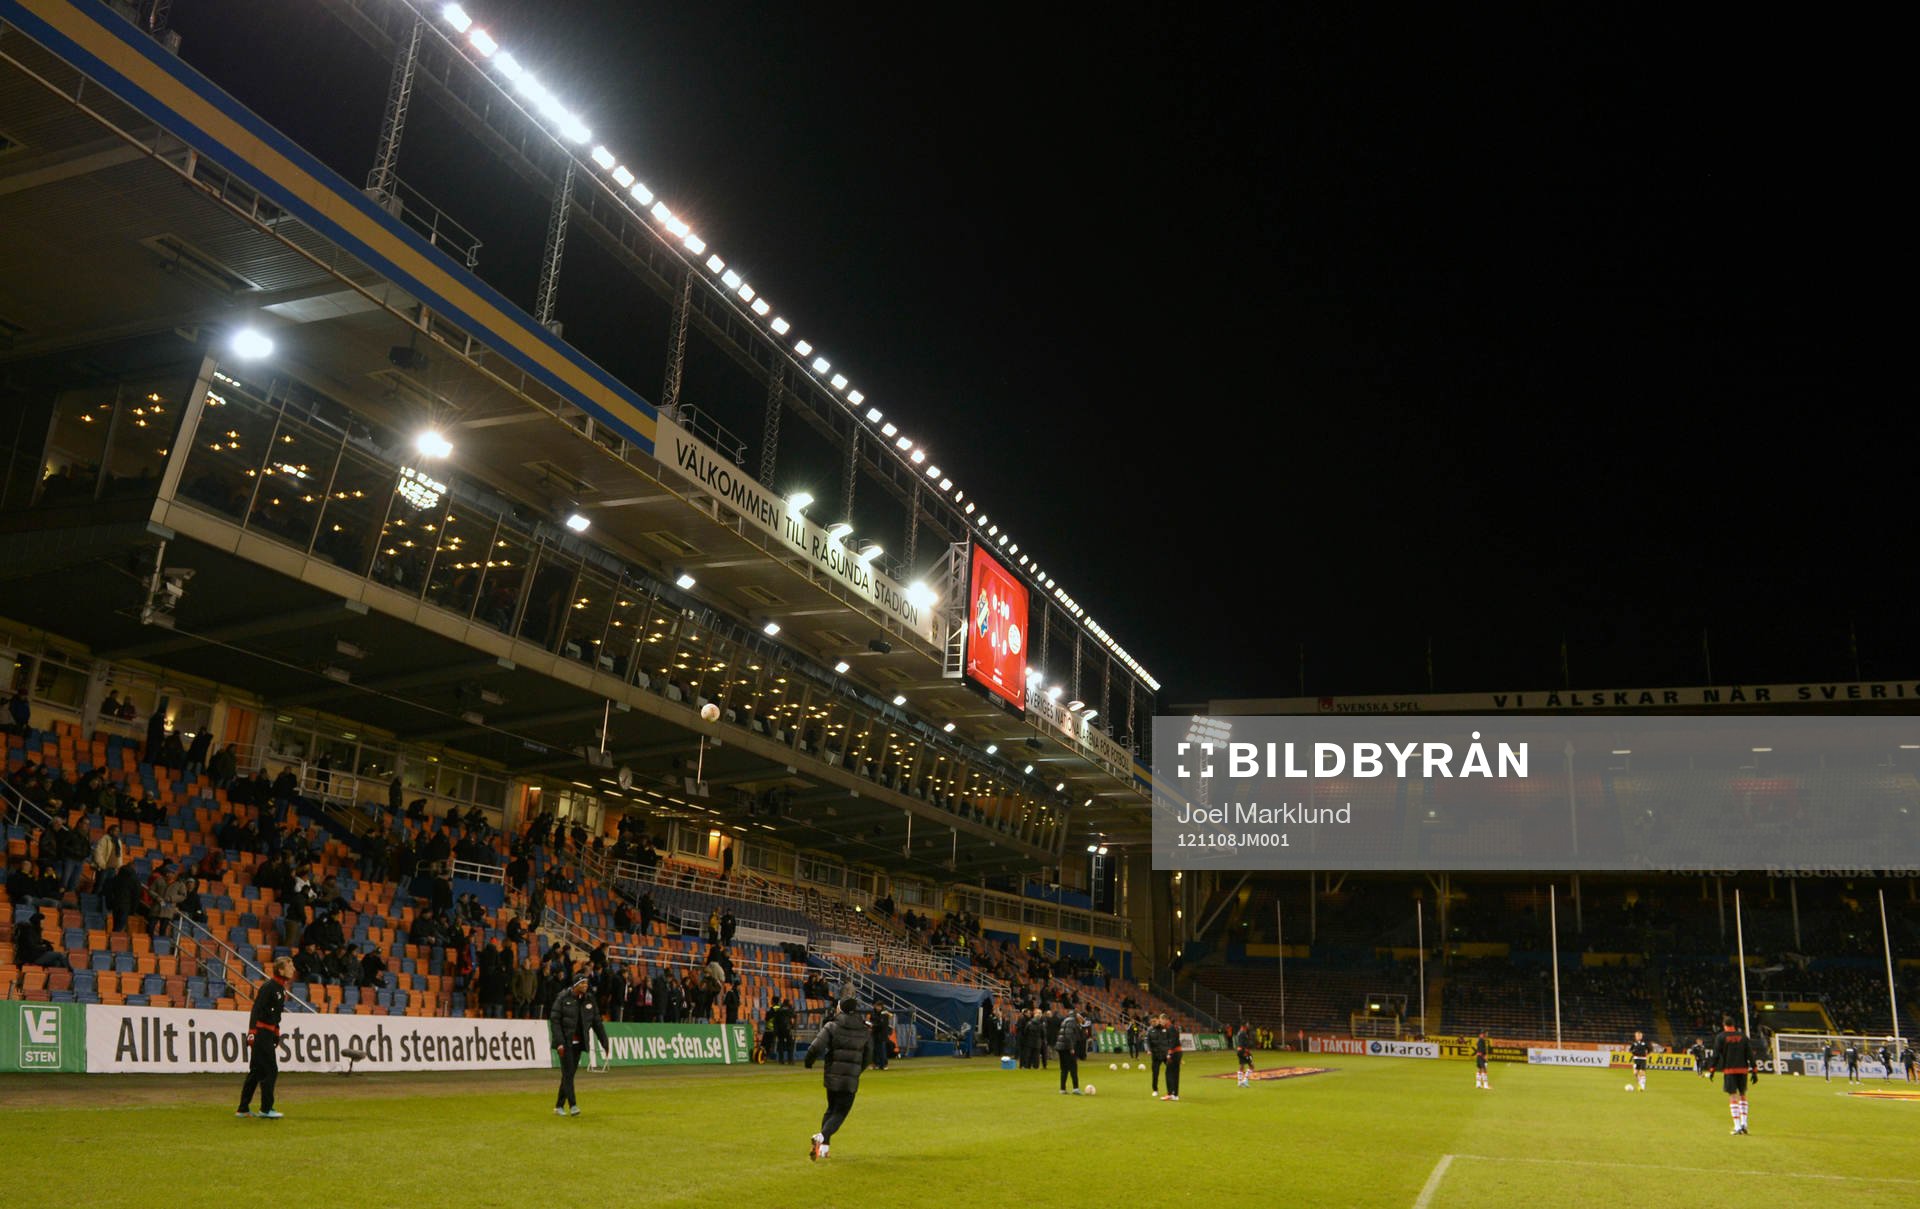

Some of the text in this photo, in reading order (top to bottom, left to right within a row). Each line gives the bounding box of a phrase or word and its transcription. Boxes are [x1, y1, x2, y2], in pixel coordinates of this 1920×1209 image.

[676, 438, 918, 626] VÄLKOMMEN TILL RÅSUNDA STADION
[1025, 687, 1054, 720] SVERIGES
[1337, 701, 1420, 712] SVENSKA SPEL
[1494, 694, 1524, 708] VI
[1547, 690, 1679, 707] ÄLSKAR
[1704, 686, 1771, 704] NÄR
[24, 1010, 57, 1044] VE
[115, 1016, 179, 1063] Allt
[279, 1026, 340, 1063] sten
[349, 1023, 393, 1063] och
[400, 1026, 536, 1063] stenarbeten
[25, 1051, 56, 1063] STEN
[1322, 1039, 1364, 1054] TAKTIK
